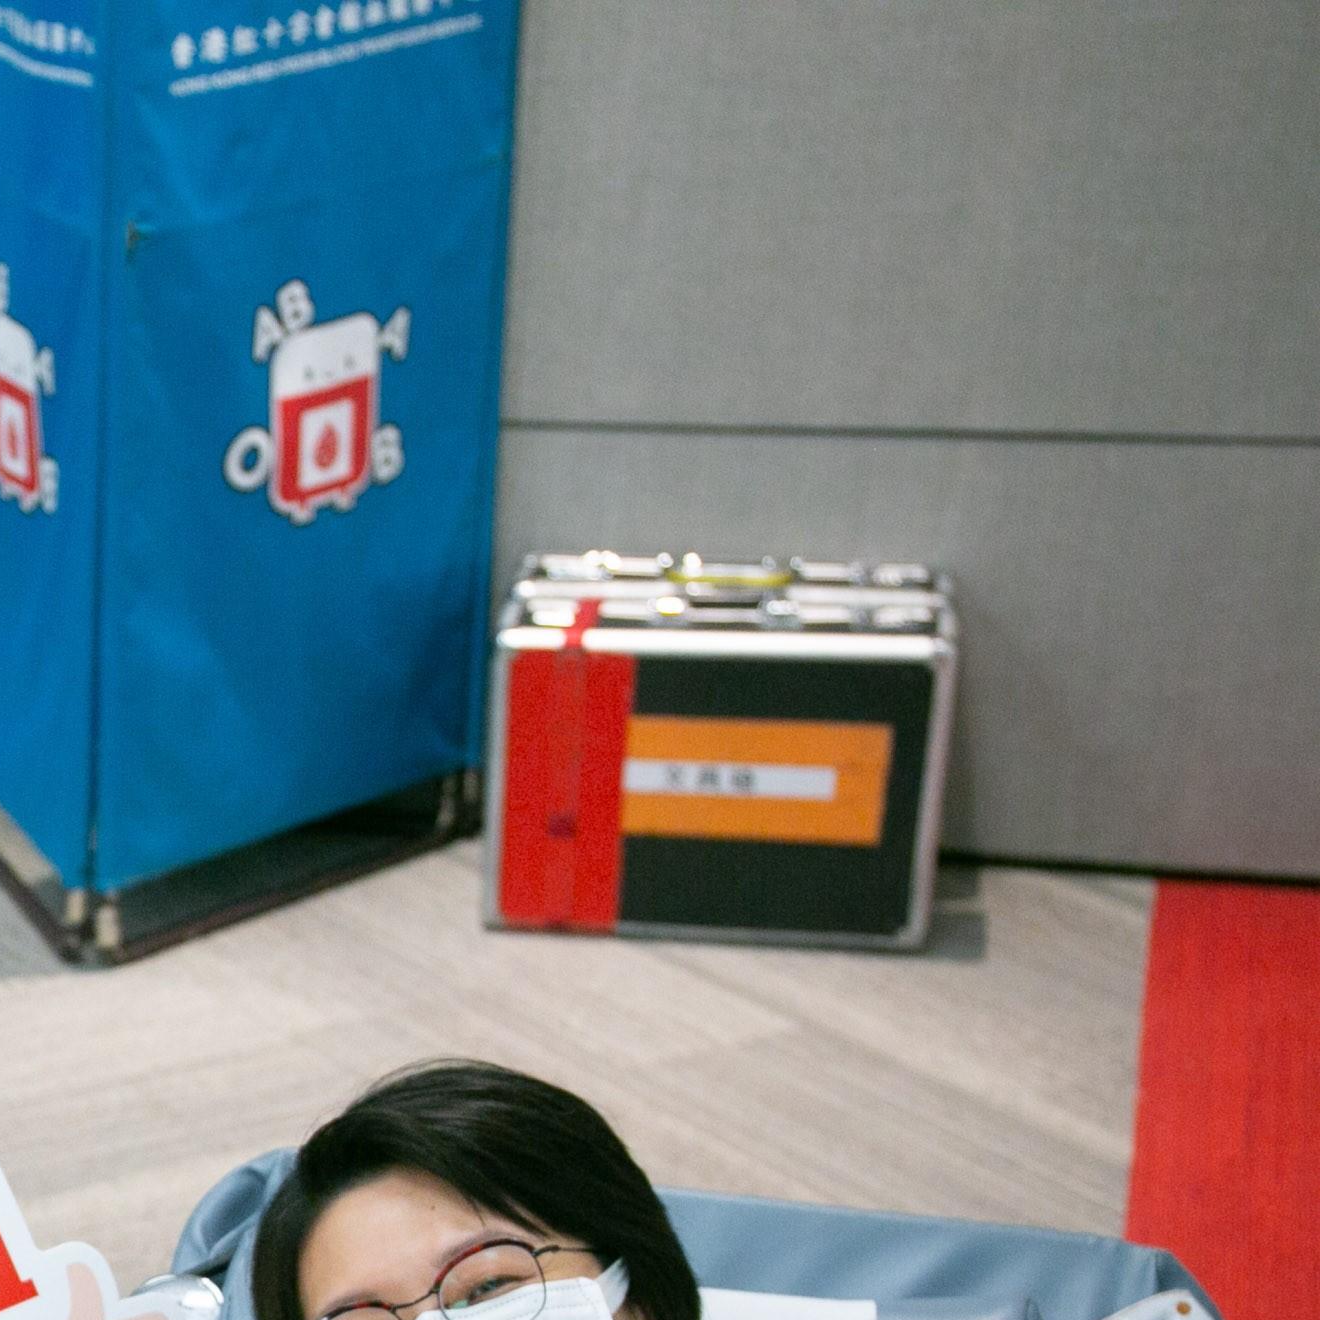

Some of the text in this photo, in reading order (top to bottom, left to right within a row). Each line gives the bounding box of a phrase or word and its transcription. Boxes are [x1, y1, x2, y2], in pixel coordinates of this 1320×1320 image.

[252, 278, 315, 363] AB
[223, 426, 271, 492] O
[372, 424, 406, 485] B
